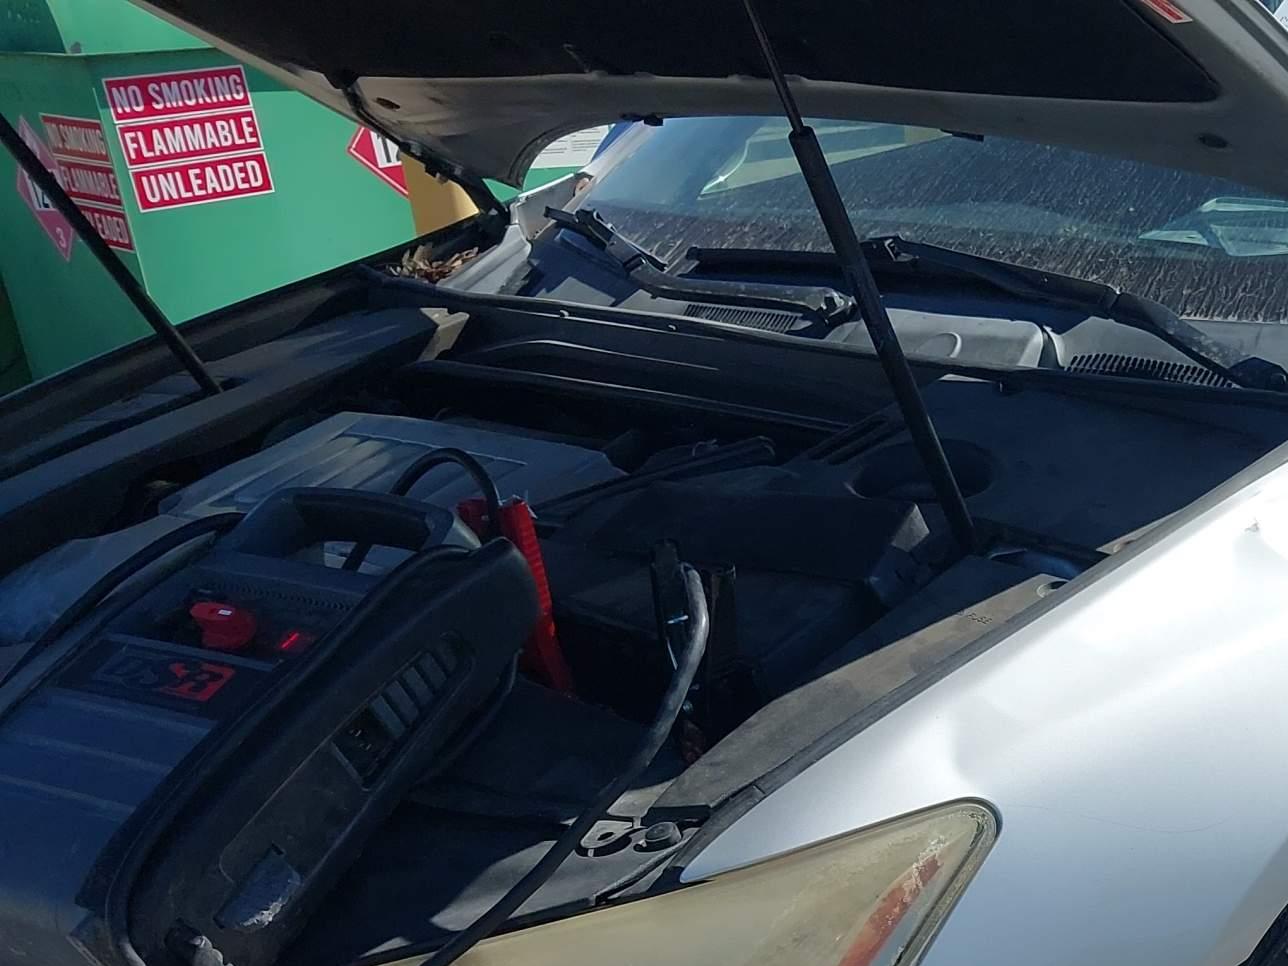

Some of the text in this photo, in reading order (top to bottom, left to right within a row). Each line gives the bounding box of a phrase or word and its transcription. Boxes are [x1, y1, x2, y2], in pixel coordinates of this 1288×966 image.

[111, 74, 245, 114] NO SMOKING
[124, 116, 258, 160] FLAMMABLE
[141, 160, 263, 203] UNLEADED
[56, 227, 67, 248] 3
